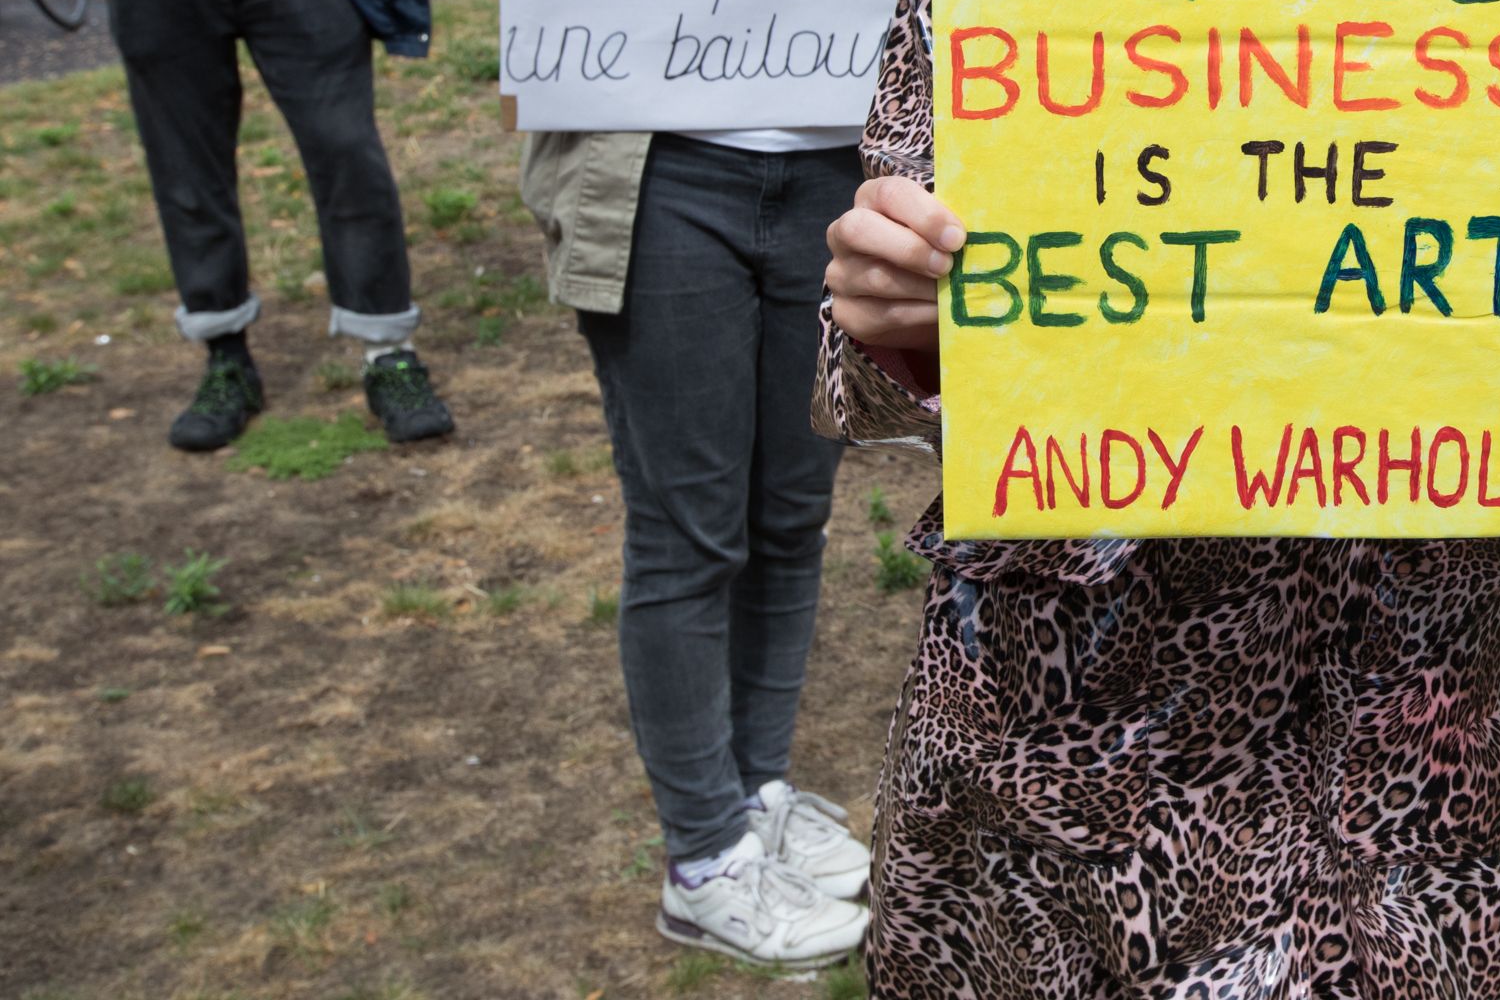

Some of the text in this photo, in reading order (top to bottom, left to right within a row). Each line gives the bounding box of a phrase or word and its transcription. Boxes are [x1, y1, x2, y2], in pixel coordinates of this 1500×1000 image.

[505, 25, 630, 83] une
[1095, 140, 1400, 208] IS THE
[950, 231, 1242, 328] BEST
[991, 424, 1205, 518] ANDY
